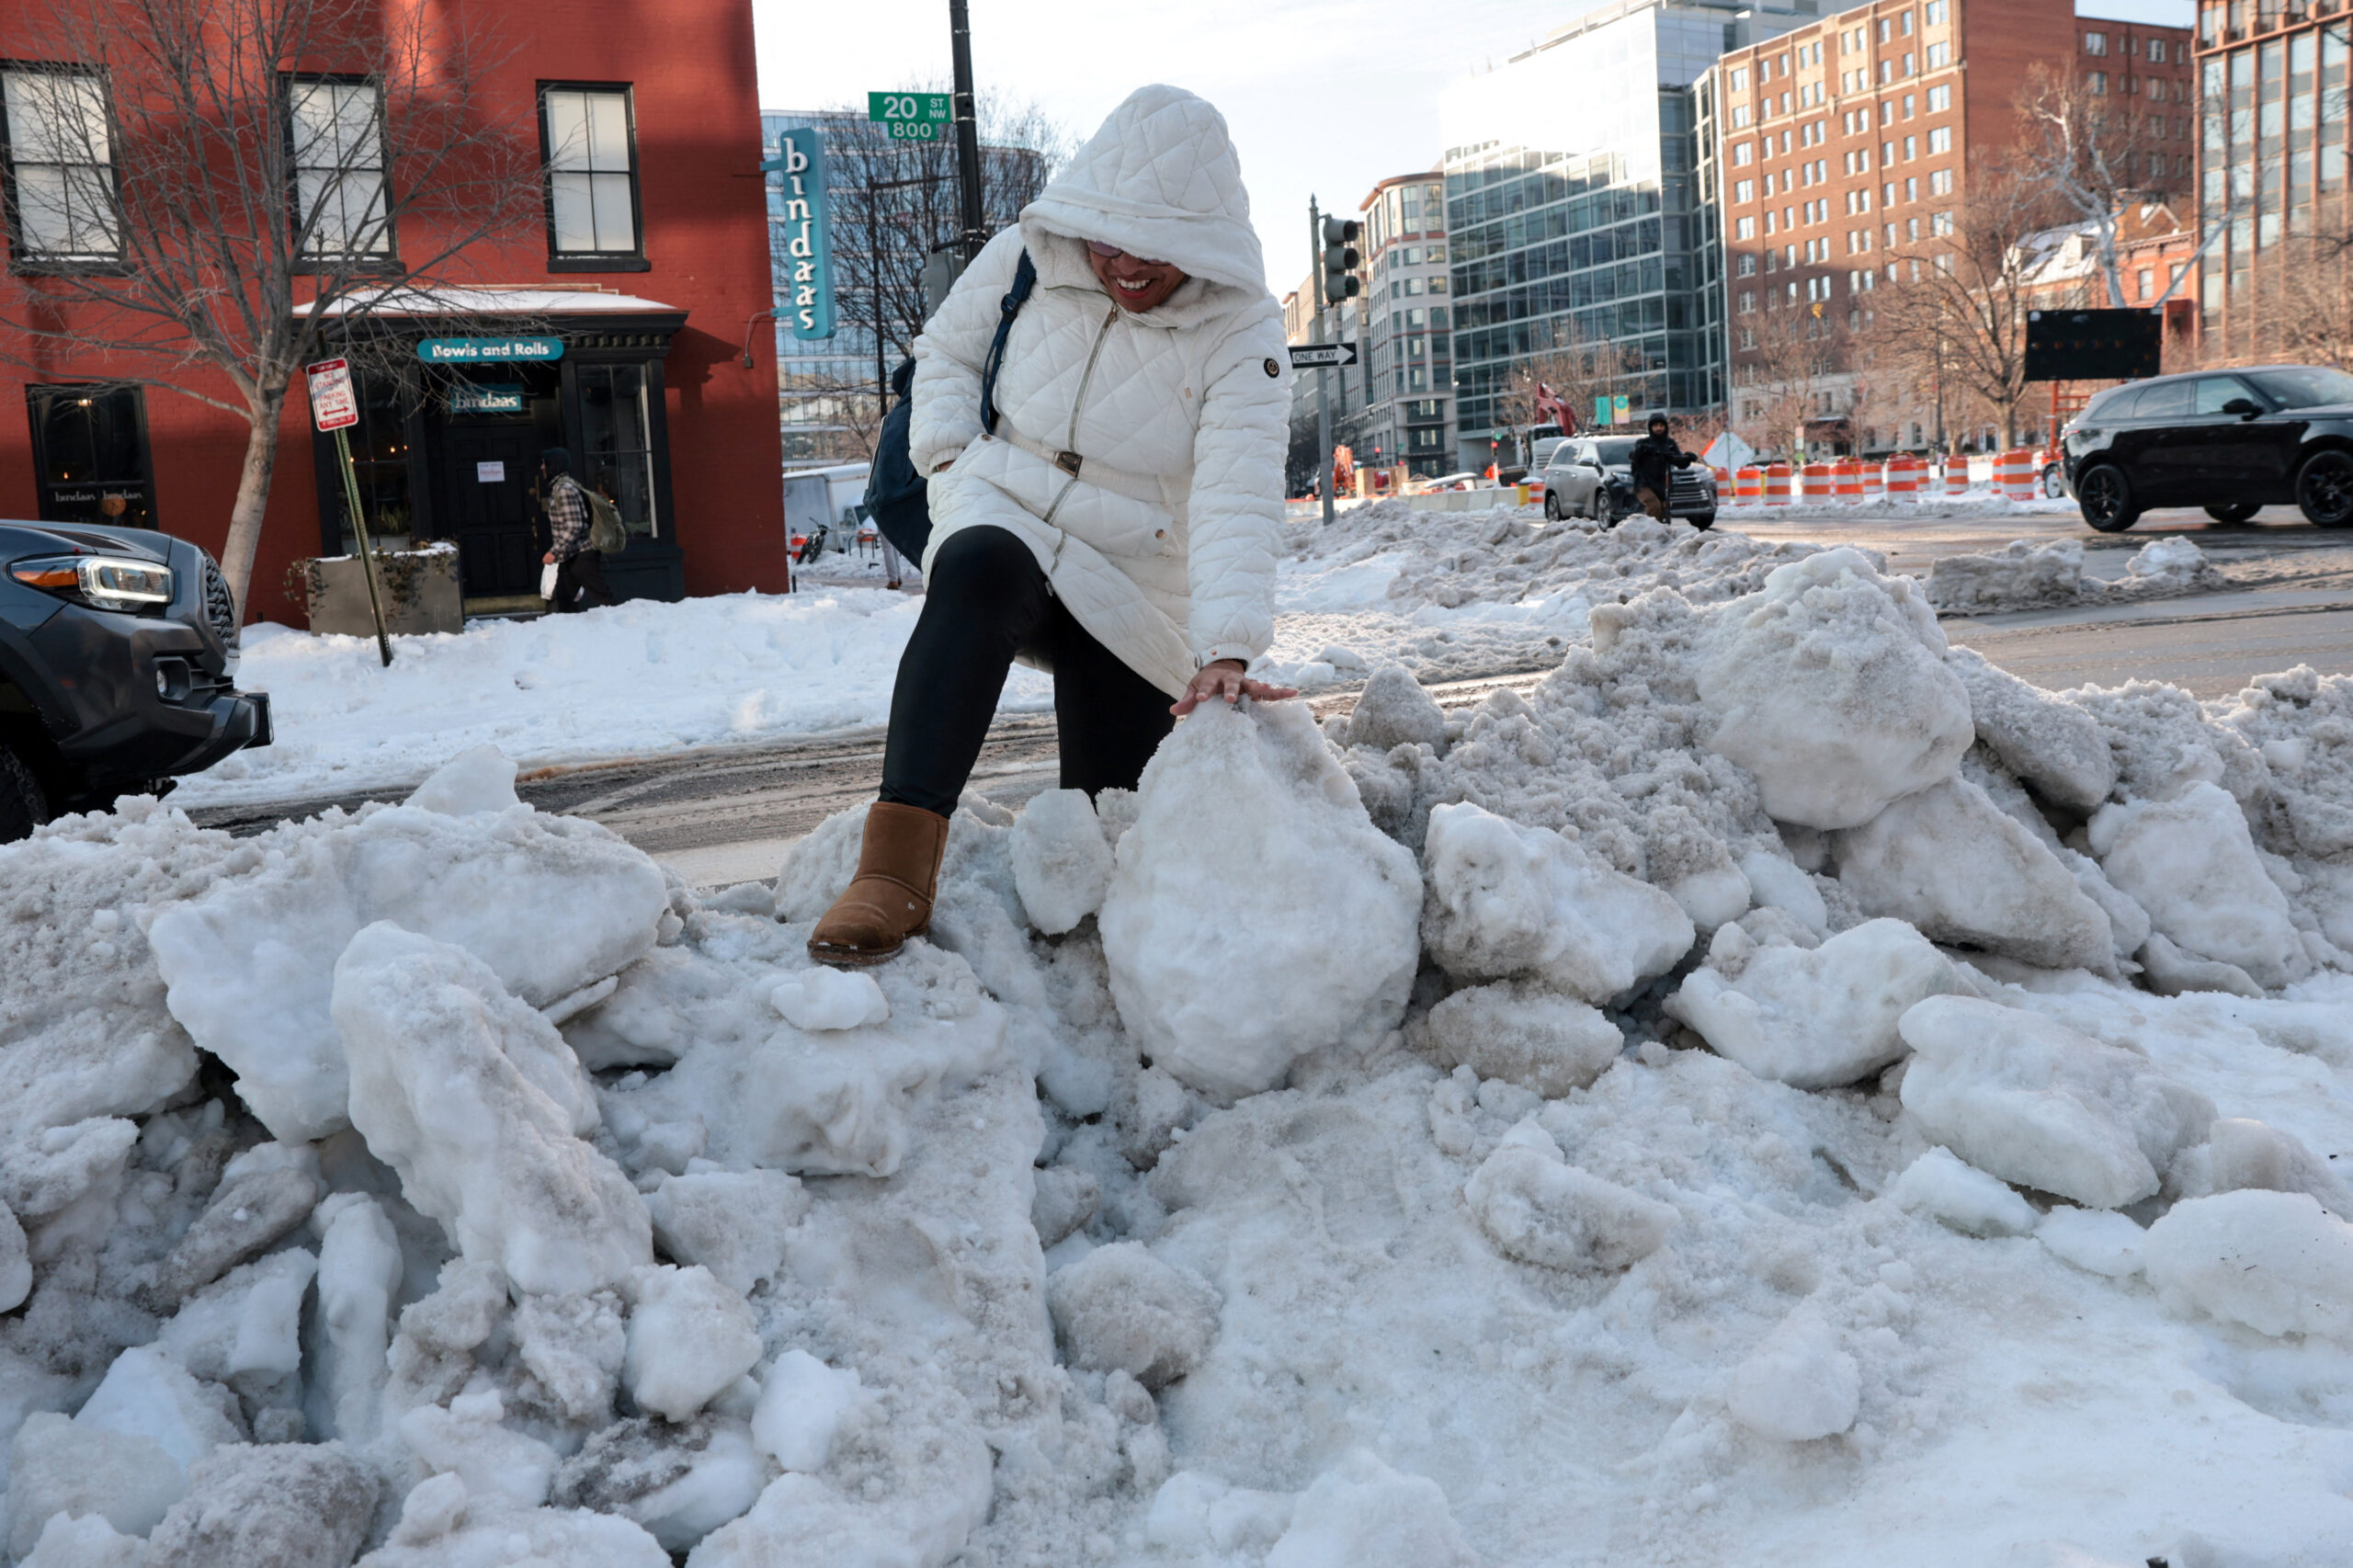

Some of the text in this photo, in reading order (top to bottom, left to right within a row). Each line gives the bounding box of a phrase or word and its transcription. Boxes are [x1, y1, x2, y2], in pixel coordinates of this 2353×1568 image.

[883, 97, 917, 119] 20
[930, 98, 944, 108] ST
[929, 109, 946, 119] NW
[893, 122, 932, 138] 800
[783, 138, 816, 330] bindaas
[432, 342, 550, 358] Bowls and Rolls
[1294, 350, 1336, 361] ONE WAY
[455, 392, 517, 409] bindaas
